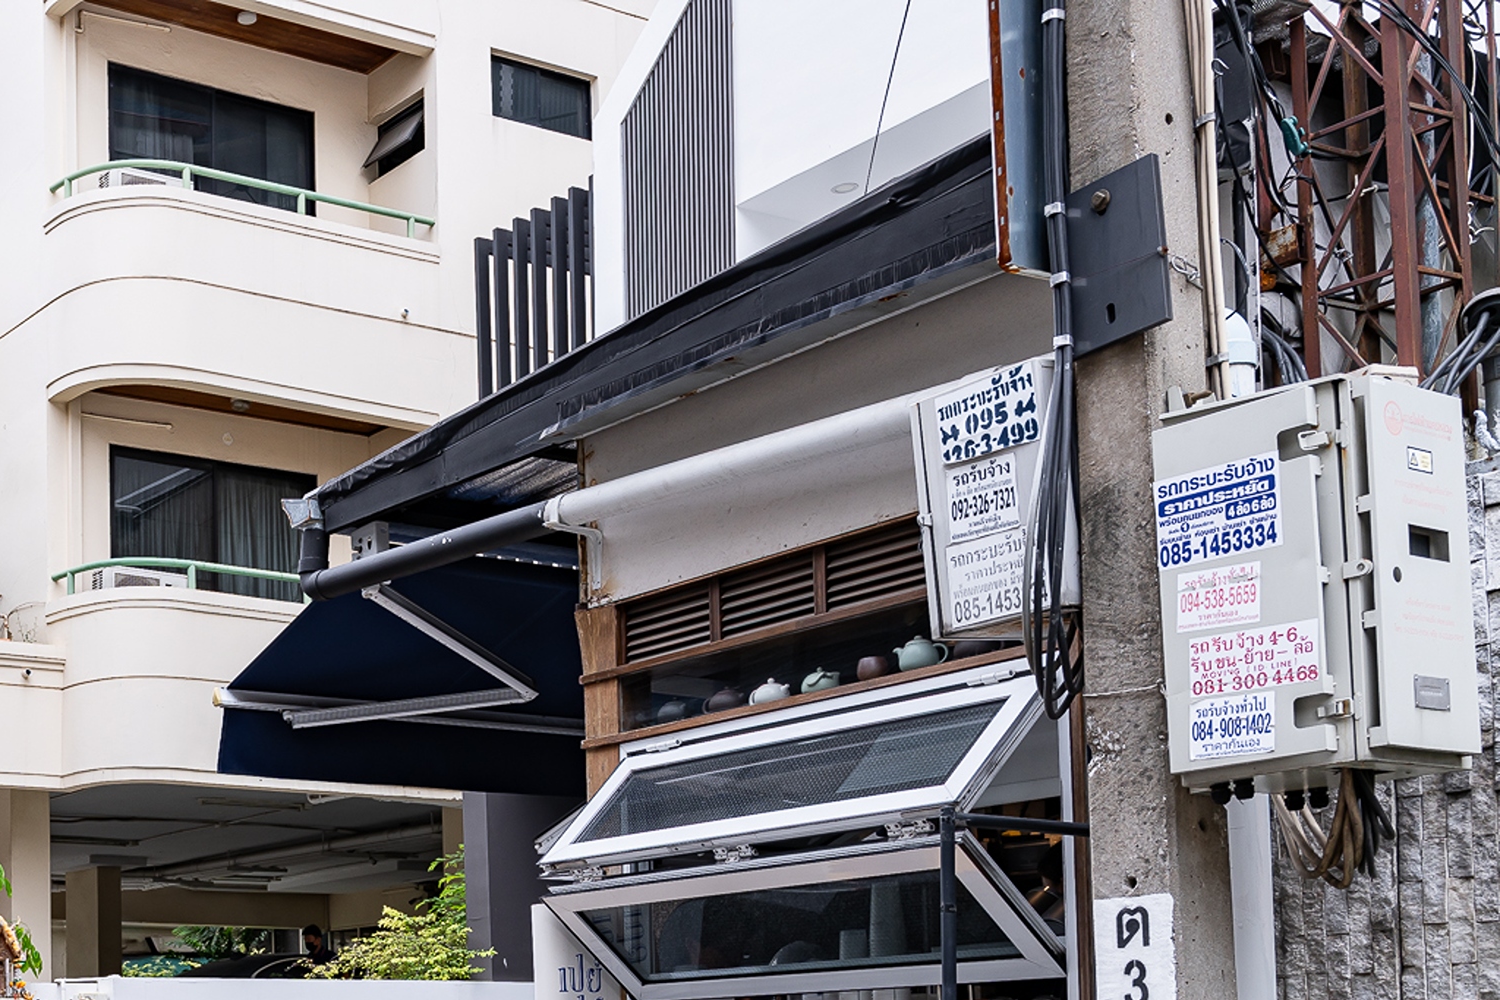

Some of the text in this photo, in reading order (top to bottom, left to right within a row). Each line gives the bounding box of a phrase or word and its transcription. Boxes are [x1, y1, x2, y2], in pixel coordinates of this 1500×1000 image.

[938, 365, 1034, 421] รถกระบะรับจ้าง
[965, 401, 1008, 435] 095
[953, 459, 1011, 487] รถรับจ้าง
[1158, 458, 1275, 499] รถกระบะรับจ้าง
[952, 486, 1016, 521] 092-326-7321
[1164, 480, 1270, 514] ราคาประหยัด
[1160, 520, 1277, 567] 085-1453334
[1181, 583, 1257, 614] 094-538-5659
[1201, 667, 1240, 680] MOVING
[1196, 694, 1266, 719] รถรับจ้างทั่วไป
[1192, 713, 1272, 742] 084-908-1402
